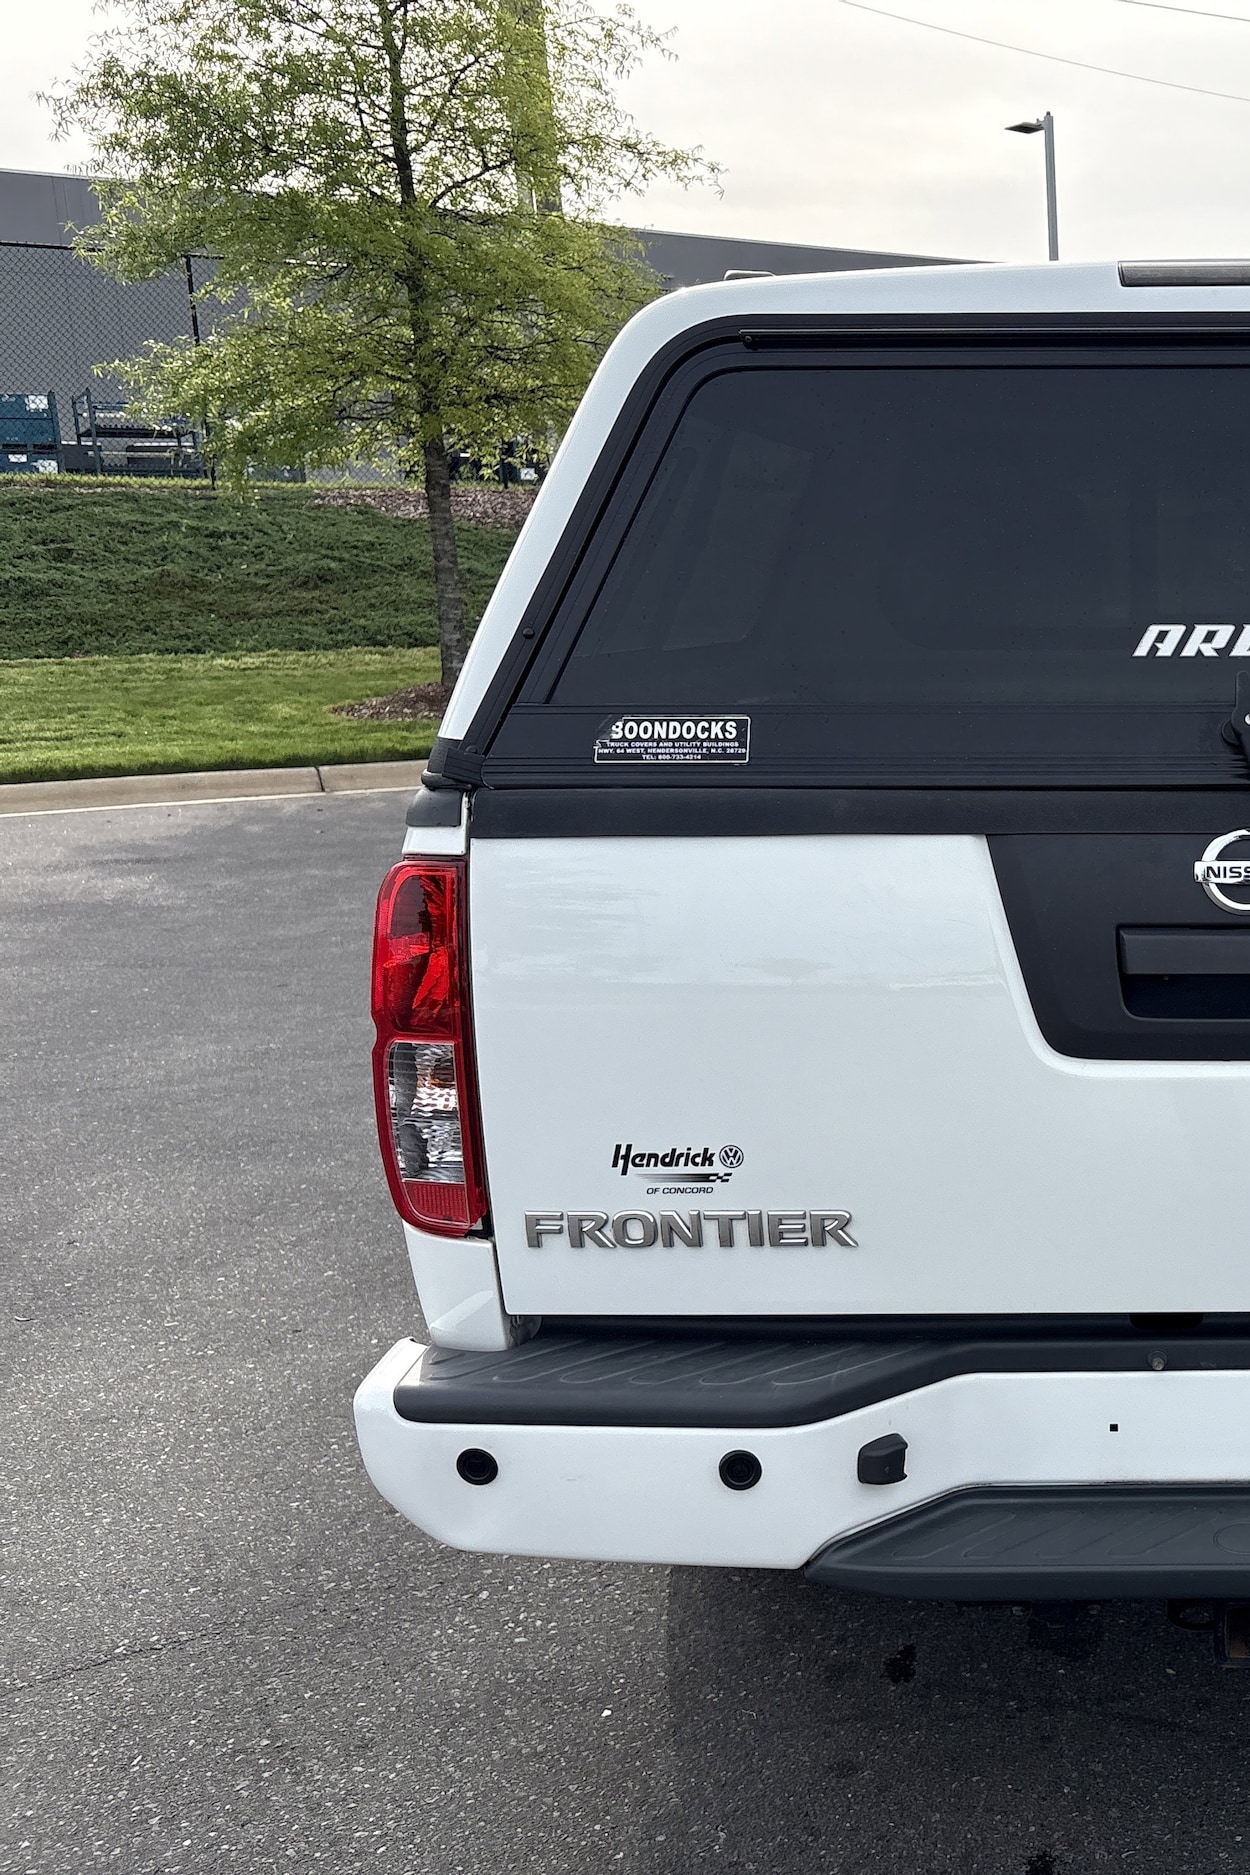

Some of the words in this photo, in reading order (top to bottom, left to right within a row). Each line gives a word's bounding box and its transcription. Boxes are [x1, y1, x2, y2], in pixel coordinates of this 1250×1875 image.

[611, 1144, 716, 1176] Hendrick
[646, 1187, 661, 1195] OF
[662, 1186, 714, 1195] CONCORD
[524, 1209, 859, 1249] FRONTIER
